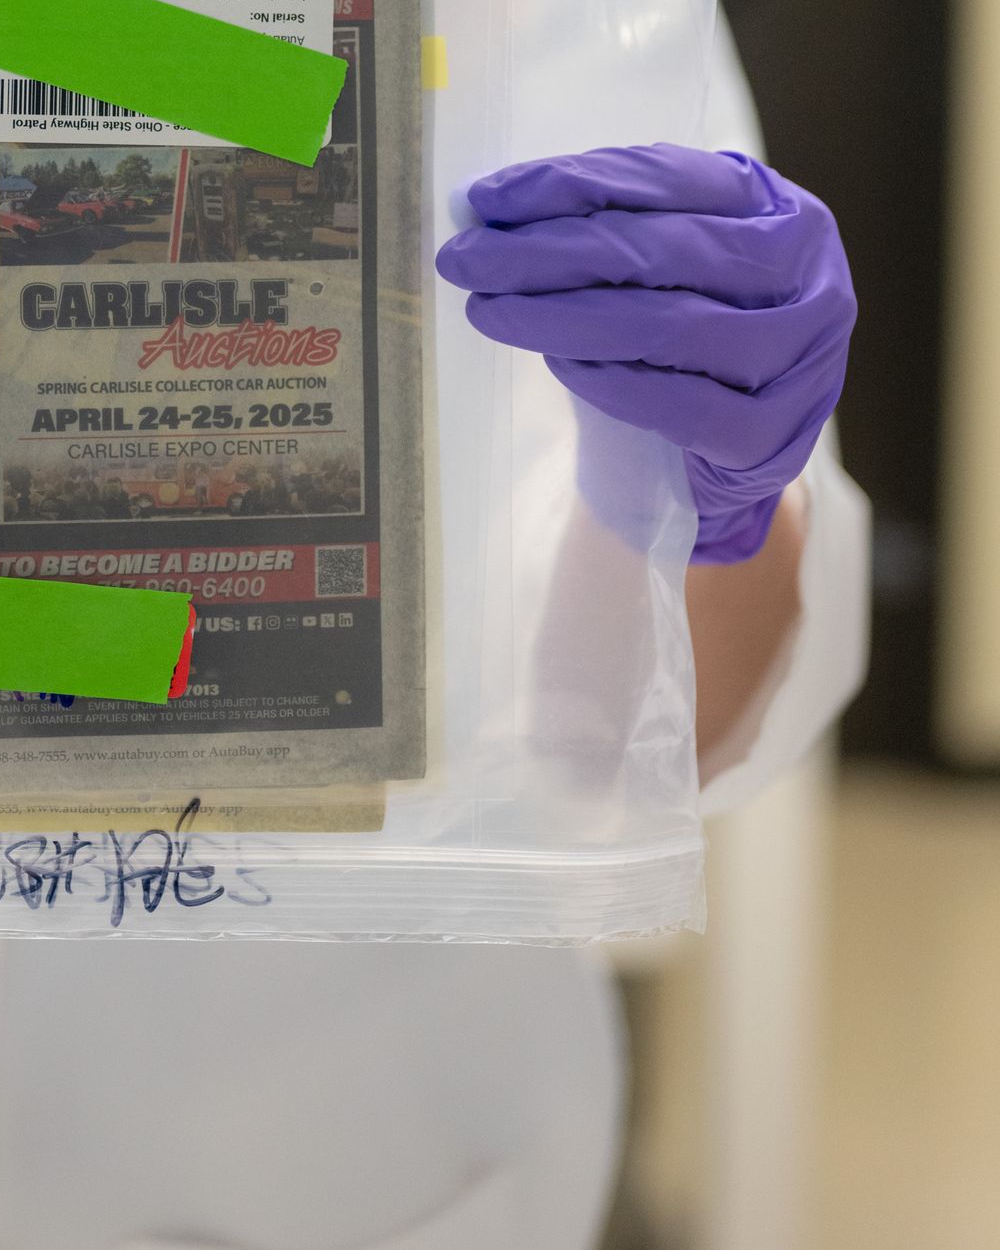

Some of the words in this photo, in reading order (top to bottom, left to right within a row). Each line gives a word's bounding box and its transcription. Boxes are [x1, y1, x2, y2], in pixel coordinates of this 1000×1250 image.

[250, 12, 269, 23] No:
[273, 12, 305, 23] Serial
[12, 119, 47, 130] Patrol
[51, 118, 99, 131] Highway
[102, 121, 132, 132] State
[135, 121, 163, 132] Ohio
[20, 278, 289, 331] CARLISLE
[138, 314, 342, 371] Auctions
[37, 381, 87, 395] SPRING
[90, 380, 152, 394] CARLISLE
[155, 378, 233, 393] COLLECTOR
[235, 378, 263, 391] CAR
[266, 377, 327, 390] AUCTION
[32, 407, 132, 433] APRIL
[138, 405, 241, 434] 24-25,
[249, 403, 332, 428] 2025
[67, 442, 159, 459] CARLISLE
[165, 441, 216, 458] EXPO
[222, 440, 298, 456] CENTER
[40, 552, 161, 577] BECOME
[162, 552, 183, 574] A
[187, 550, 295, 573] BIDDER
[205, 617, 241, 632] US:
[192, 749, 204, 758] or
[209, 745, 262, 760] AutaBuy
[266, 747, 290, 759] app
